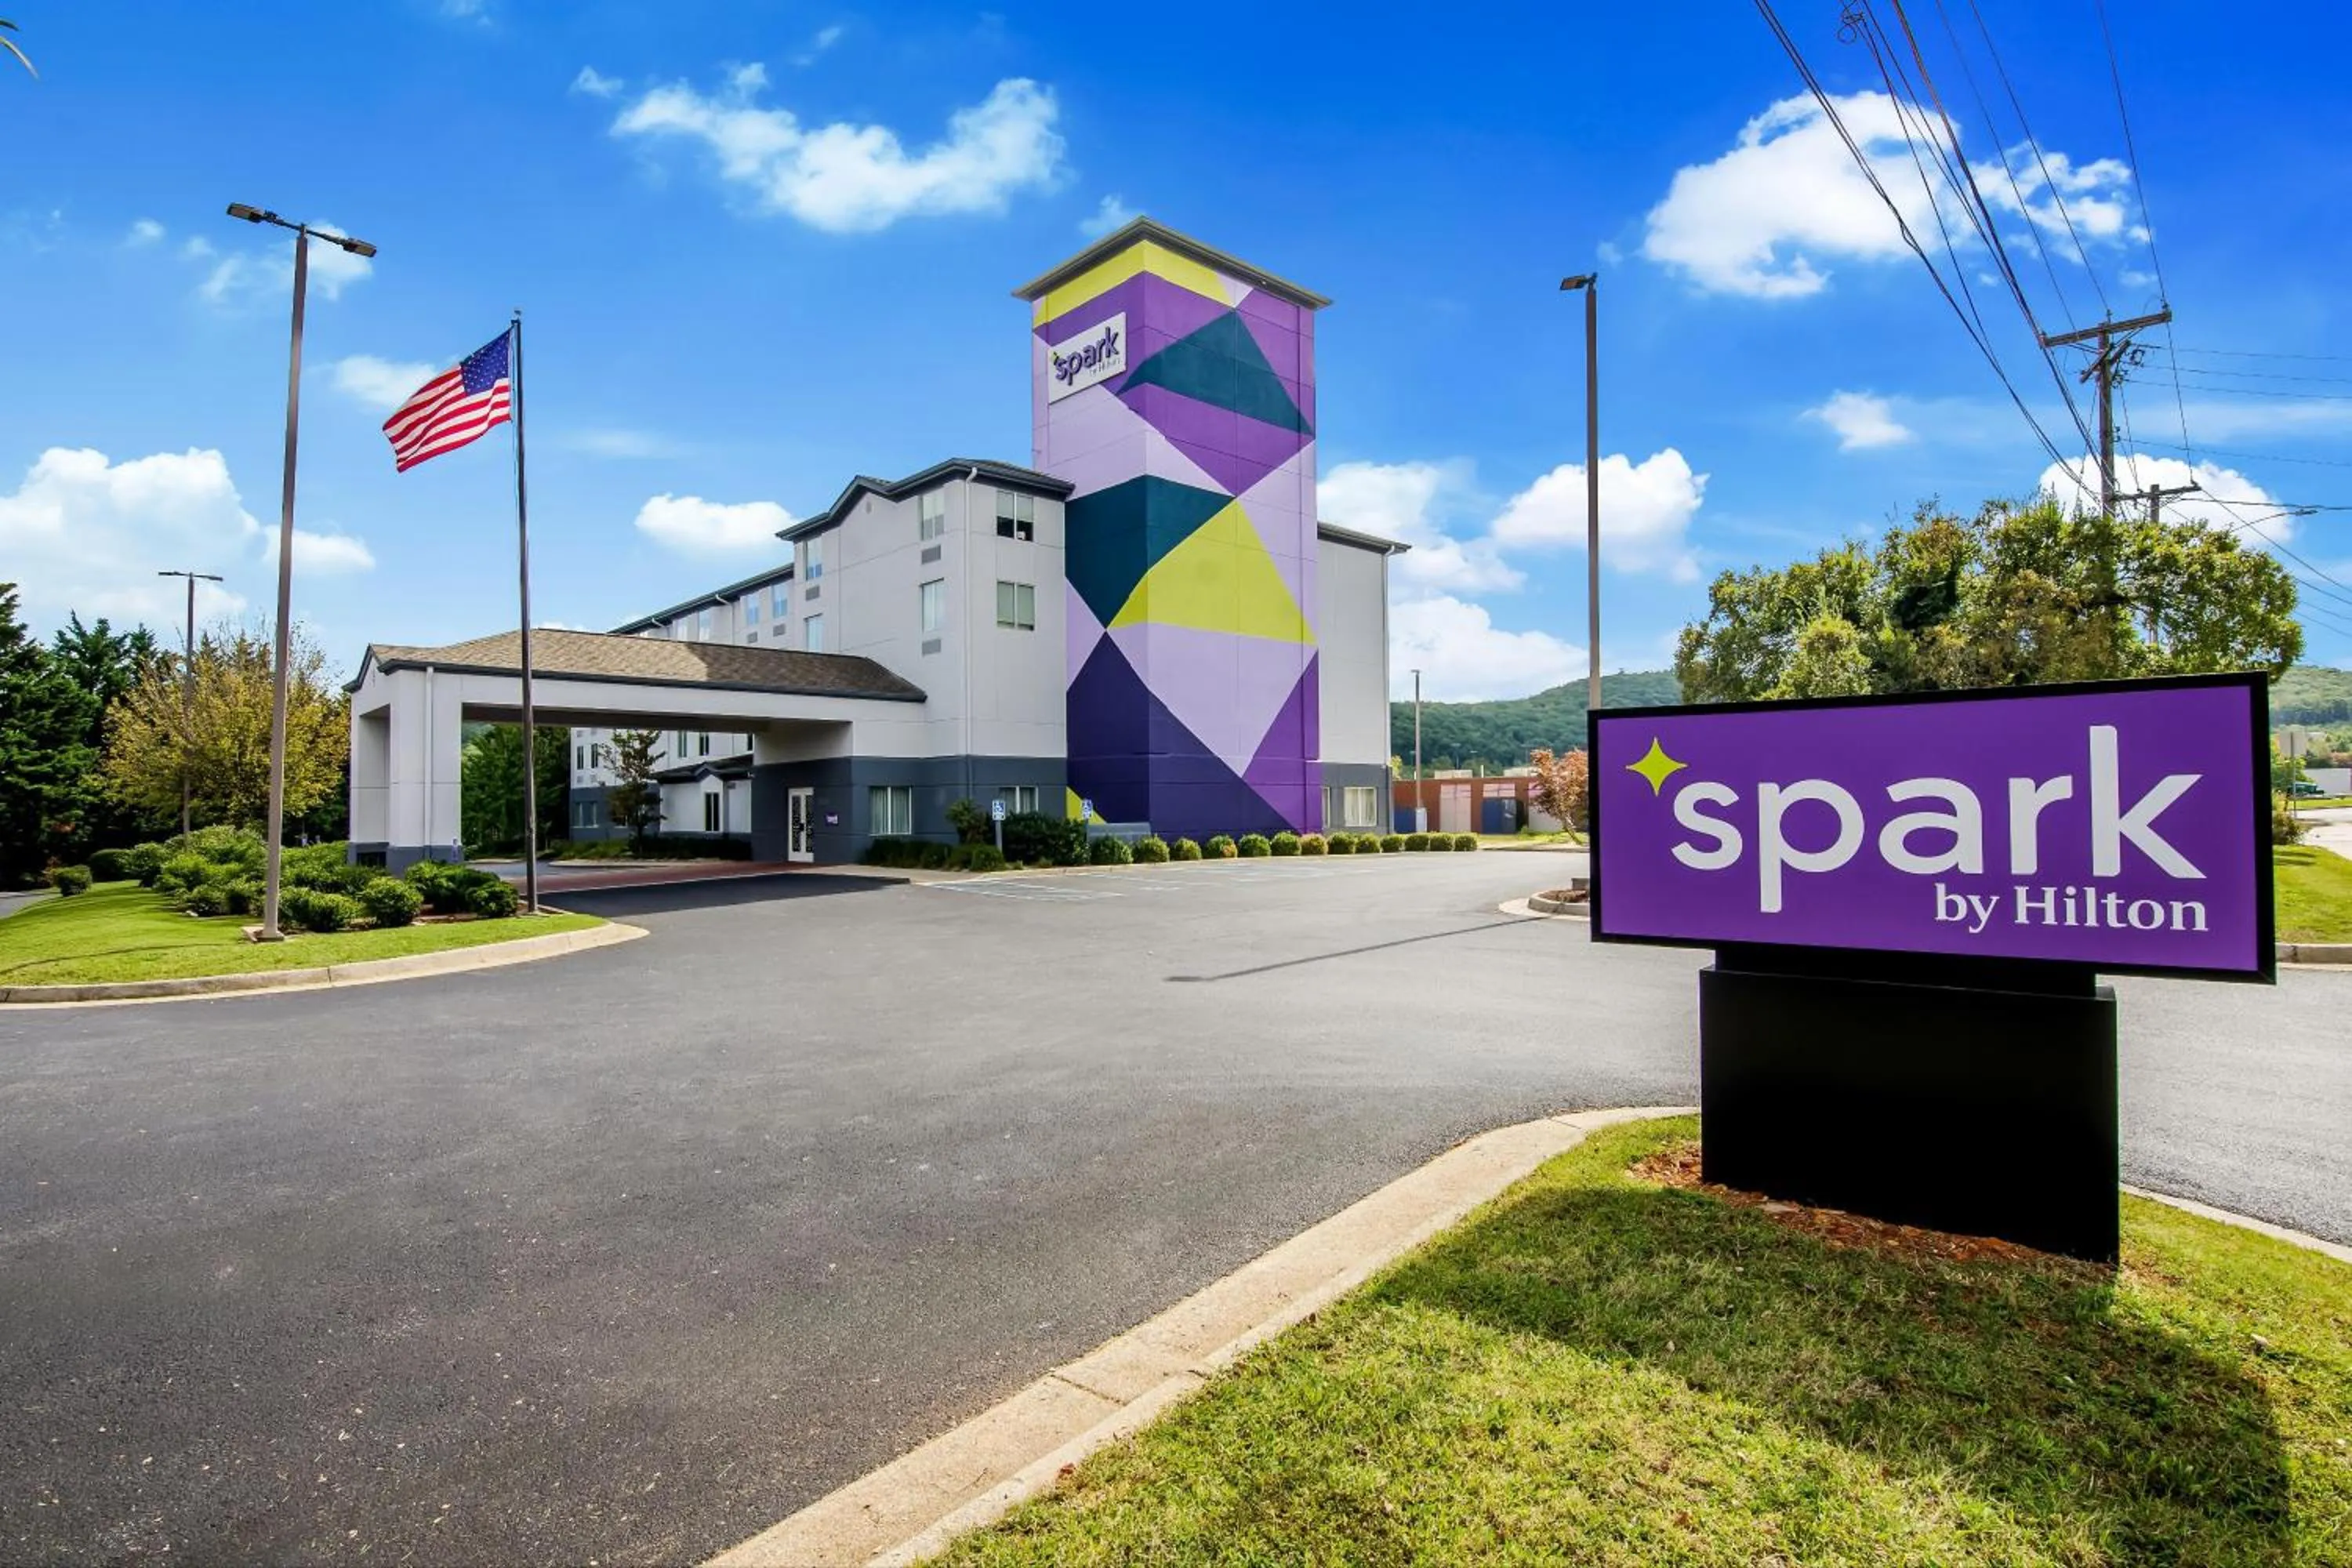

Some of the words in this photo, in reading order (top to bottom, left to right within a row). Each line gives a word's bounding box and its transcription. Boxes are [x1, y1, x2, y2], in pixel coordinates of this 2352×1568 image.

[1054, 326, 1120, 386] spark
[1671, 724, 2207, 914] spark
[1934, 882, 2000, 934] by
[2014, 885, 2209, 932] Hilton
